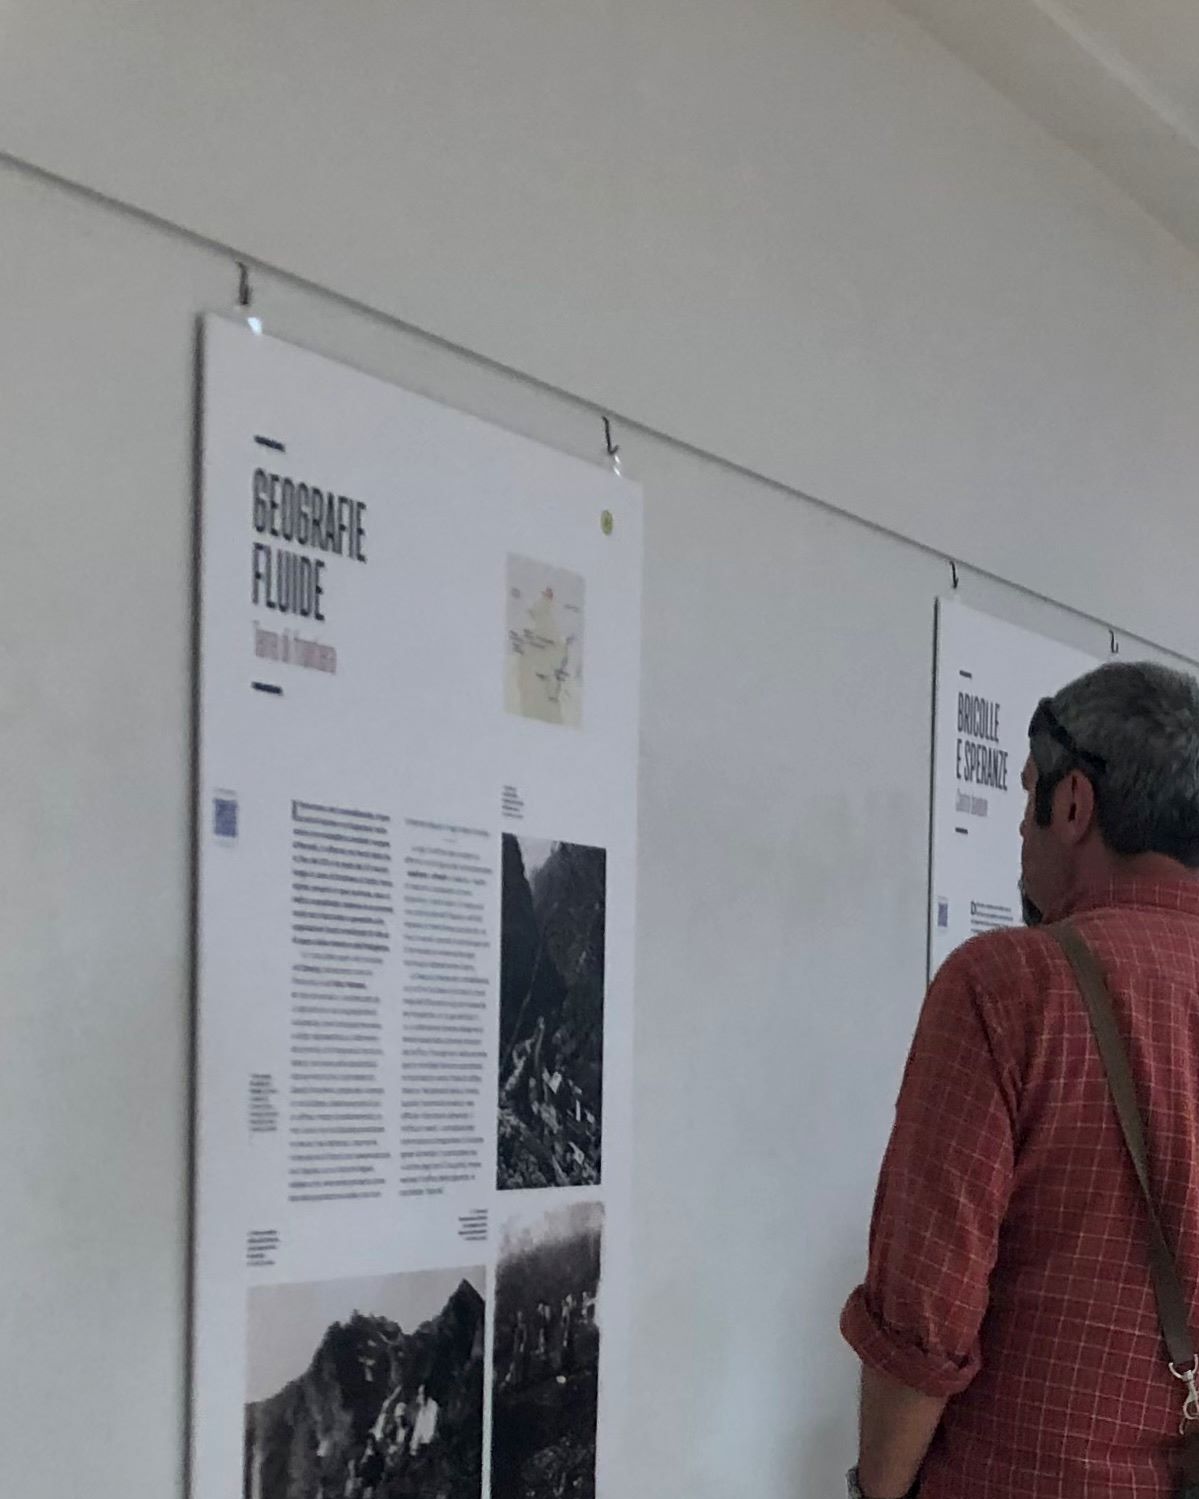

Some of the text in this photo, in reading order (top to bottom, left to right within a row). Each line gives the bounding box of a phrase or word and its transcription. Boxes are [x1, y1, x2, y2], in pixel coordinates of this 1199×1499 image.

[253, 467, 367, 564] GEOGRAFIE
[252, 542, 325, 622] FLUIDE
[957, 691, 1000, 742] BRICOLLE
[956, 738, 1008, 791] E SPERANZE
